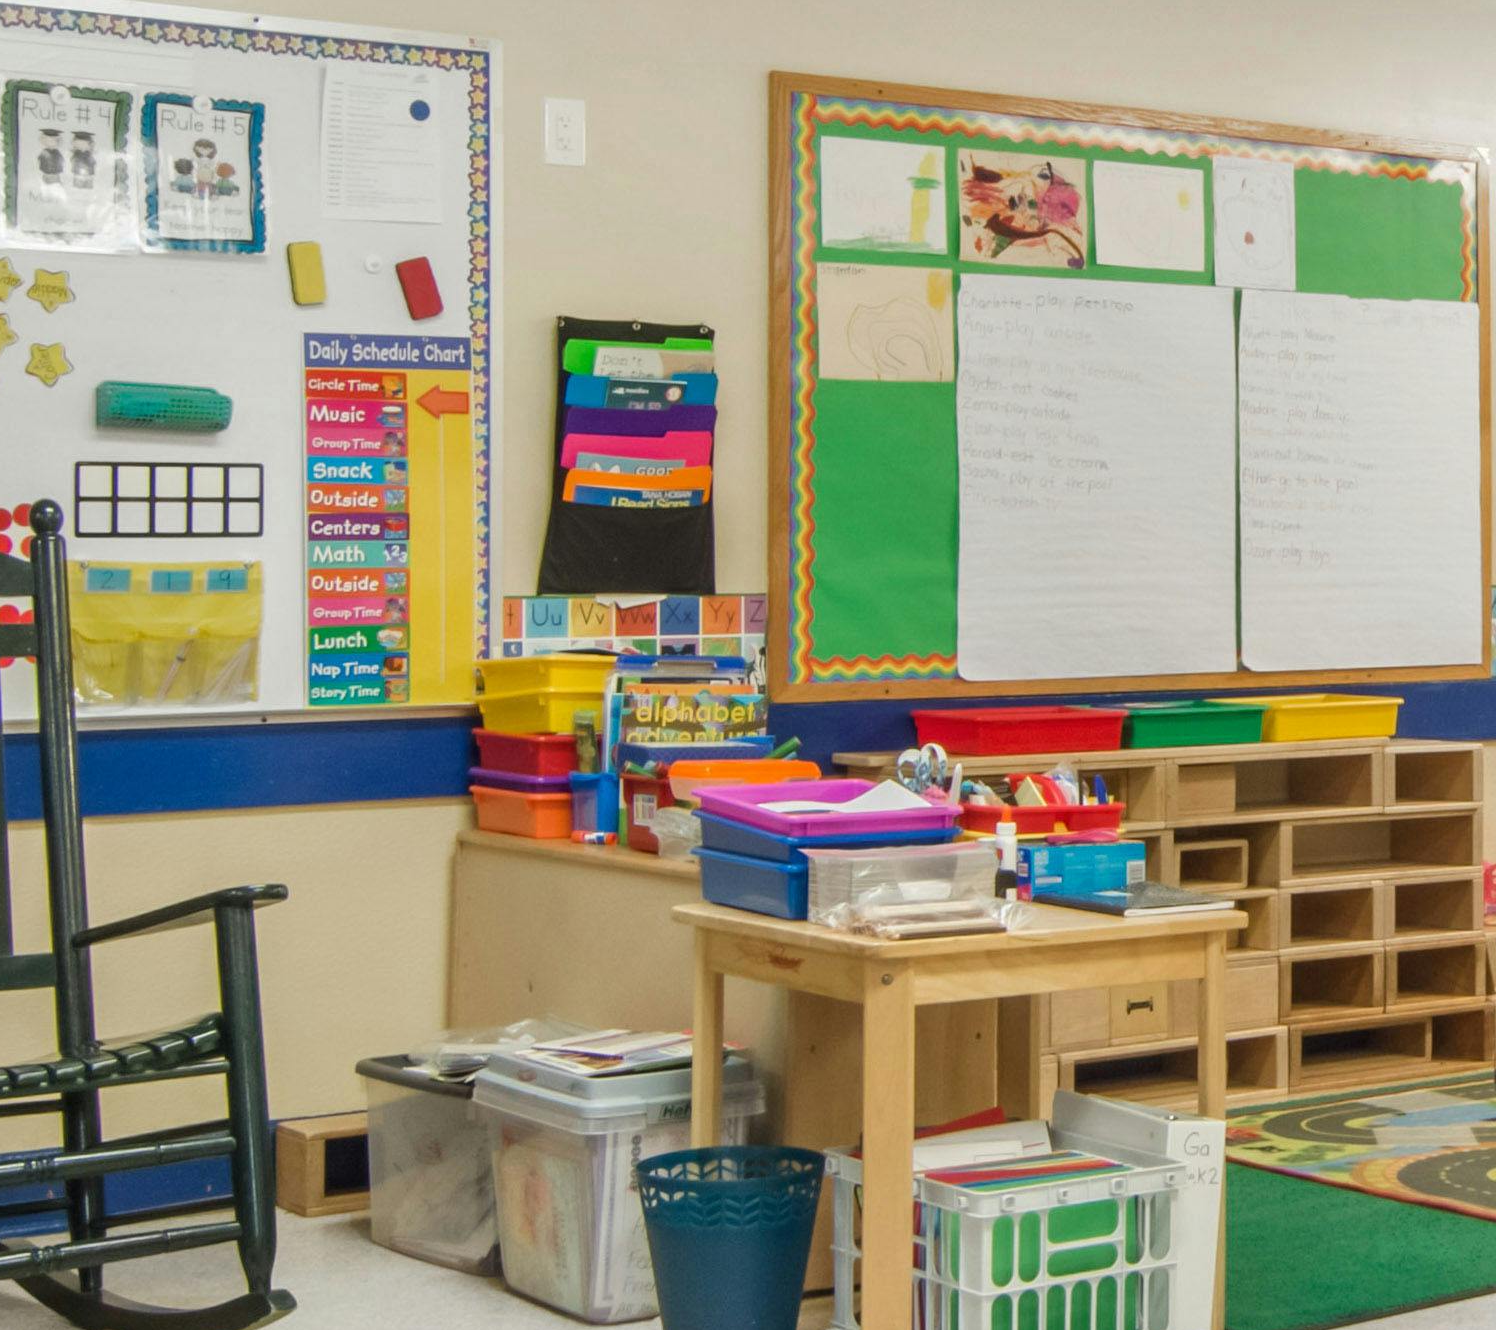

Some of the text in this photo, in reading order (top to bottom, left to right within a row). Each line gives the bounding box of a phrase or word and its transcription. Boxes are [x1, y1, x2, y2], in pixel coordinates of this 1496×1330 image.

[21, 97, 68, 122] Rule
[97, 106, 113, 128] 4
[160, 108, 204, 133] Rule
[233, 117, 246, 136] 5
[309, 340, 466, 366] Daily Schedule Chart
[308, 378, 379, 392] Circle Time
[309, 404, 366, 423] Music
[311, 436, 381, 451] Group Time
[312, 461, 373, 480] Snack
[310, 489, 379, 508] Outside
[310, 519, 381, 536] Centers
[312, 544, 366, 563] Math
[100, 570, 116, 590] 2
[218, 570, 232, 590] 9
[311, 575, 379, 592] Outside
[313, 606, 382, 621] Group Time
[531, 602, 562, 627] Uu
[579, 602, 605, 625] Vv
[665, 602, 693, 624] Xx
[709, 601, 734, 631] Yy
[313, 631, 368, 649] Lunch
[311, 661, 379, 679] Nap Time
[311, 685, 381, 700] Story Time
[635, 701, 755, 726] alphabet
